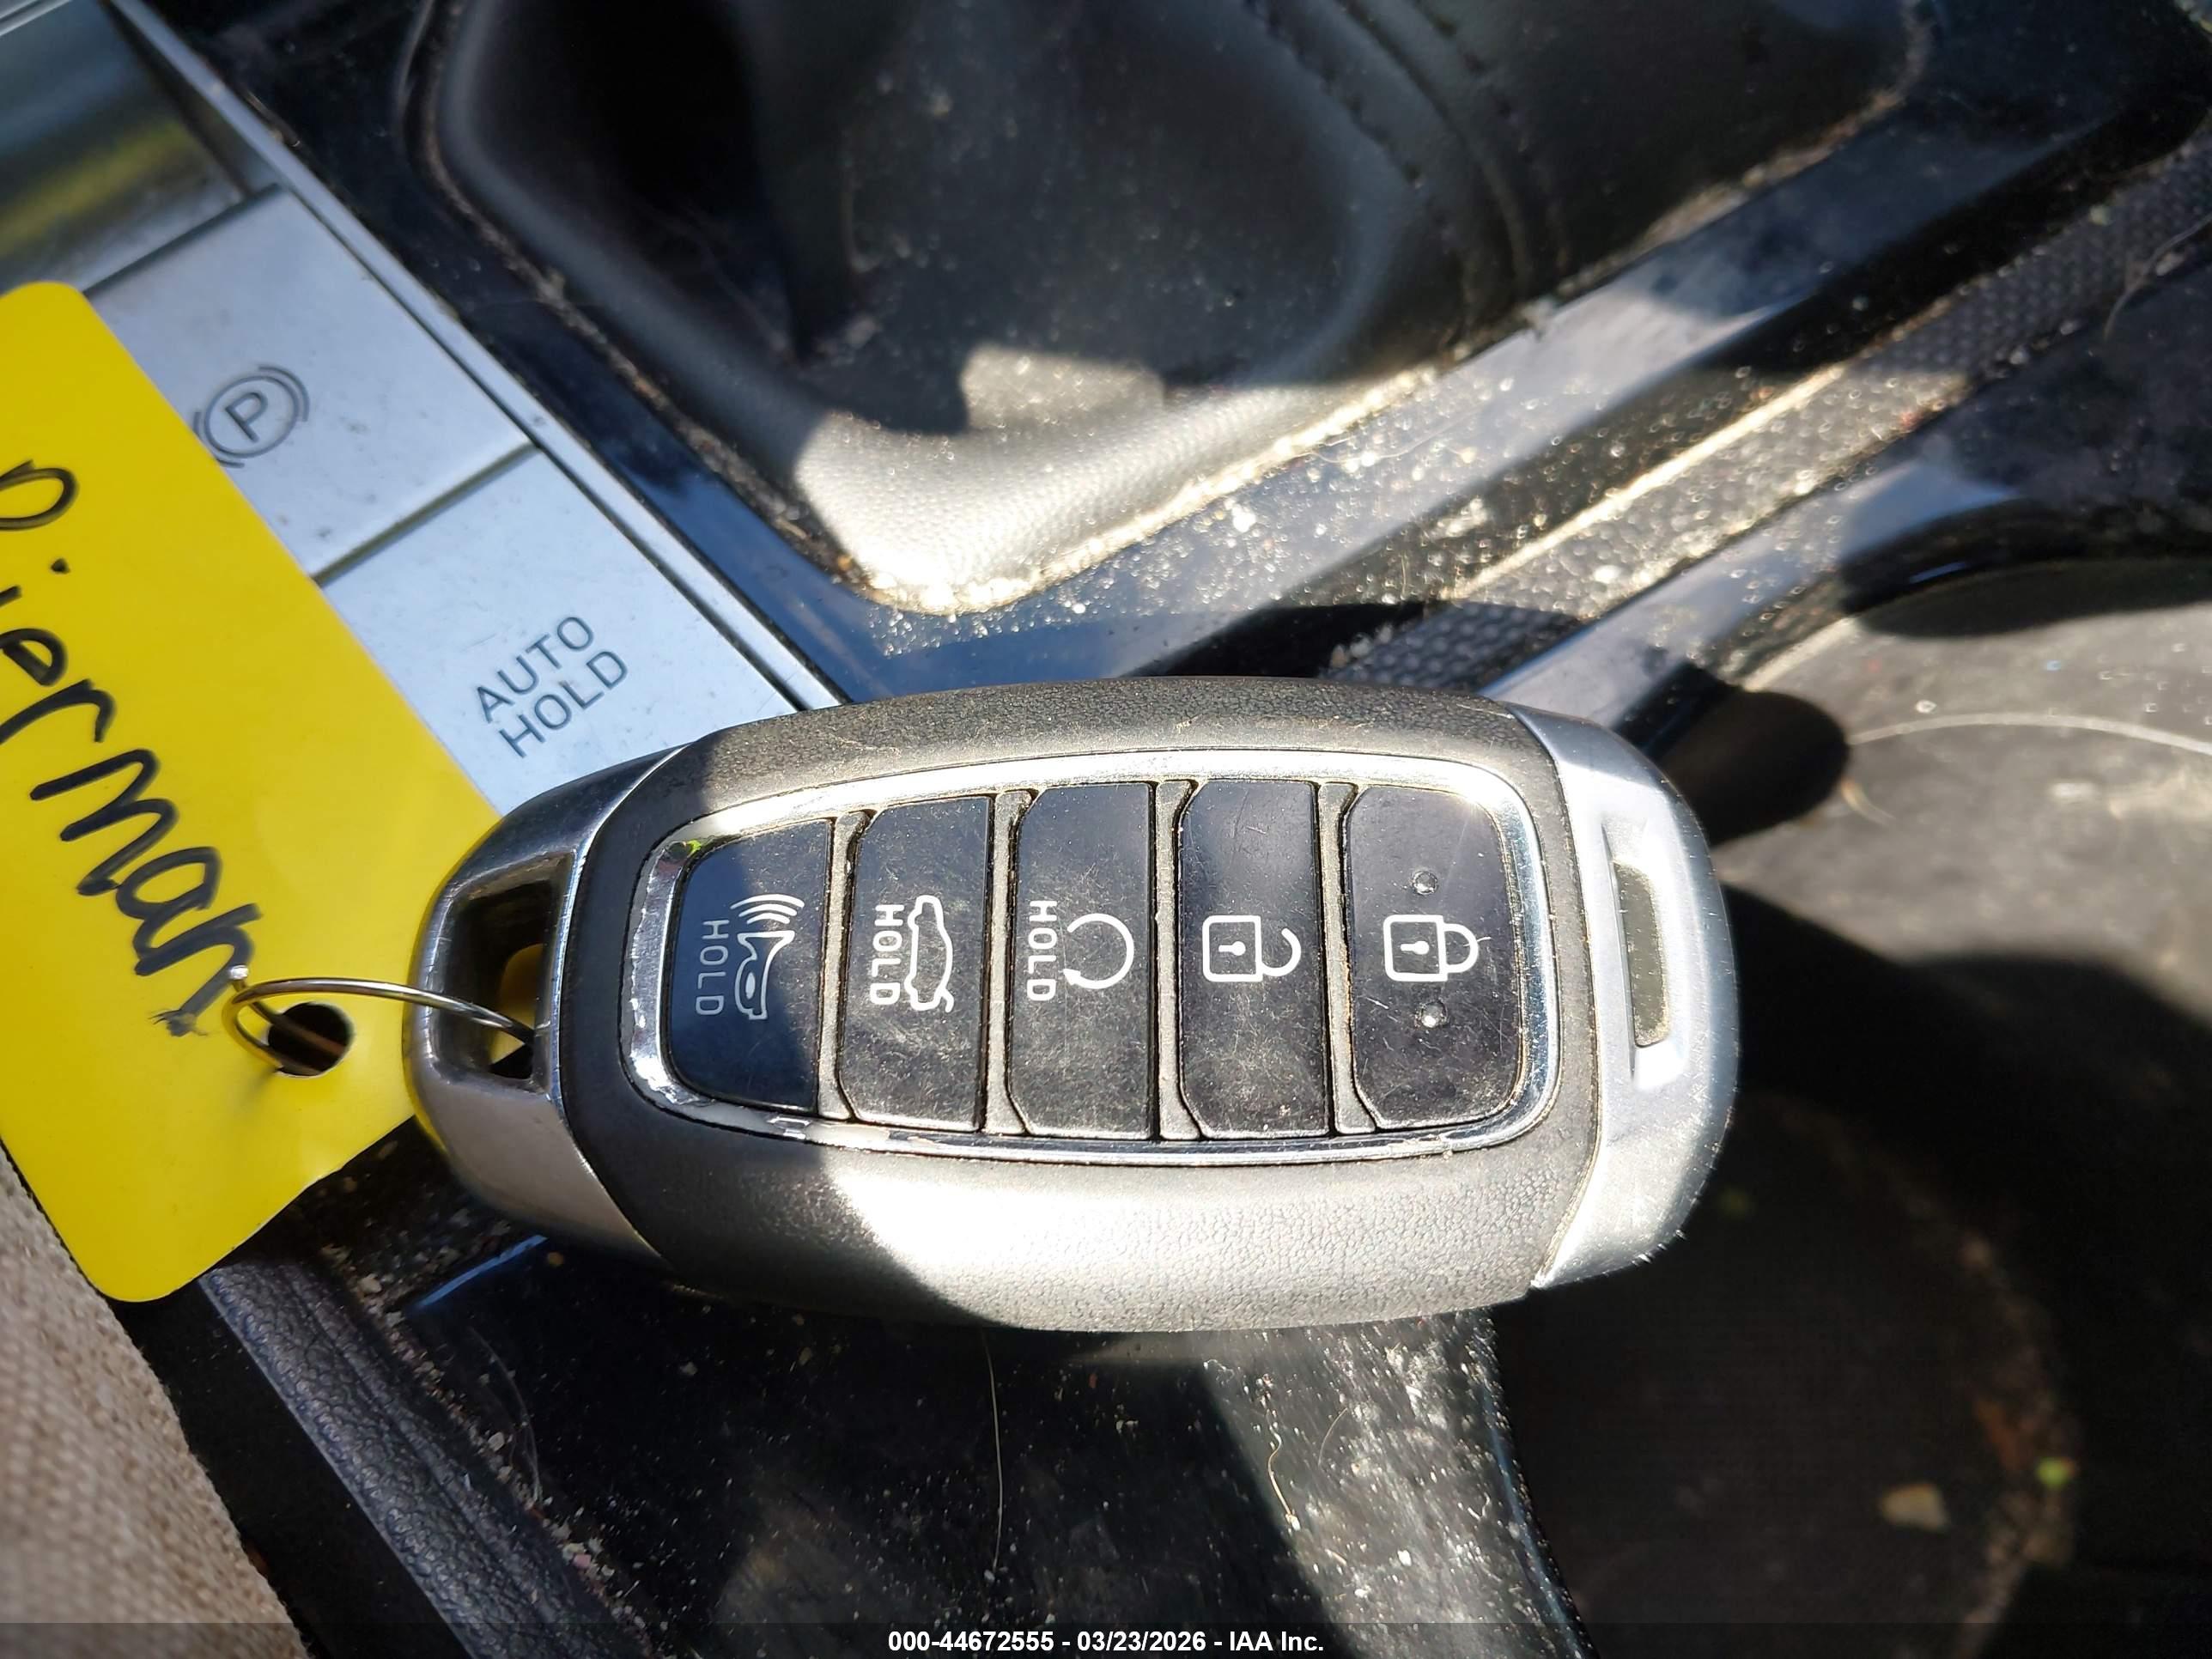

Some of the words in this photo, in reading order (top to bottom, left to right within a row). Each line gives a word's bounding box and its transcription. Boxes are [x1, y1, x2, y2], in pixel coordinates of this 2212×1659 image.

[476, 616, 594, 722] AUTO
[499, 650, 627, 757] HOLD
[696, 920, 730, 1015] HOLD
[870, 904, 904, 1005] HOLD
[1026, 900, 1058, 1001] HOLD
